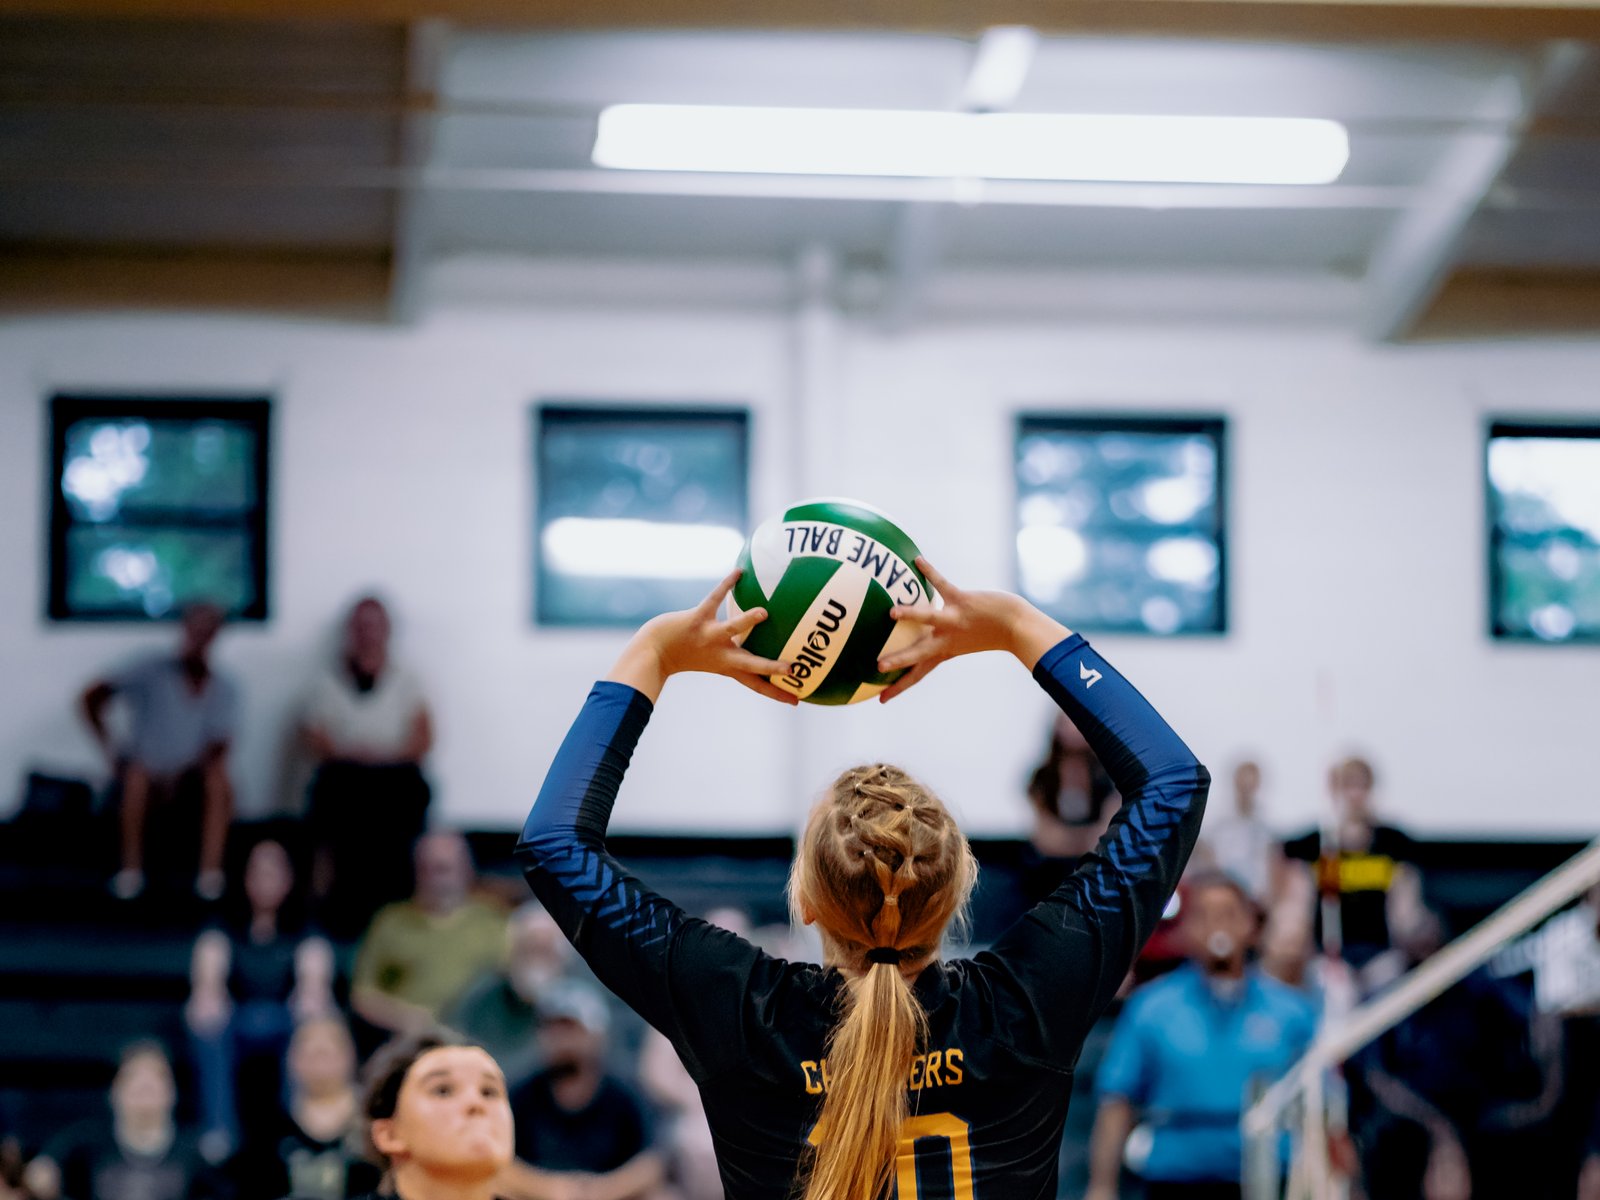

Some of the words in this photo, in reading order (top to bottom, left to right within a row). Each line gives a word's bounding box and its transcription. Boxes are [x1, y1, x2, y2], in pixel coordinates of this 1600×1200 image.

[784, 526, 844, 556] BALL
[846, 536, 921, 606] GAME
[782, 598, 847, 689] molten
